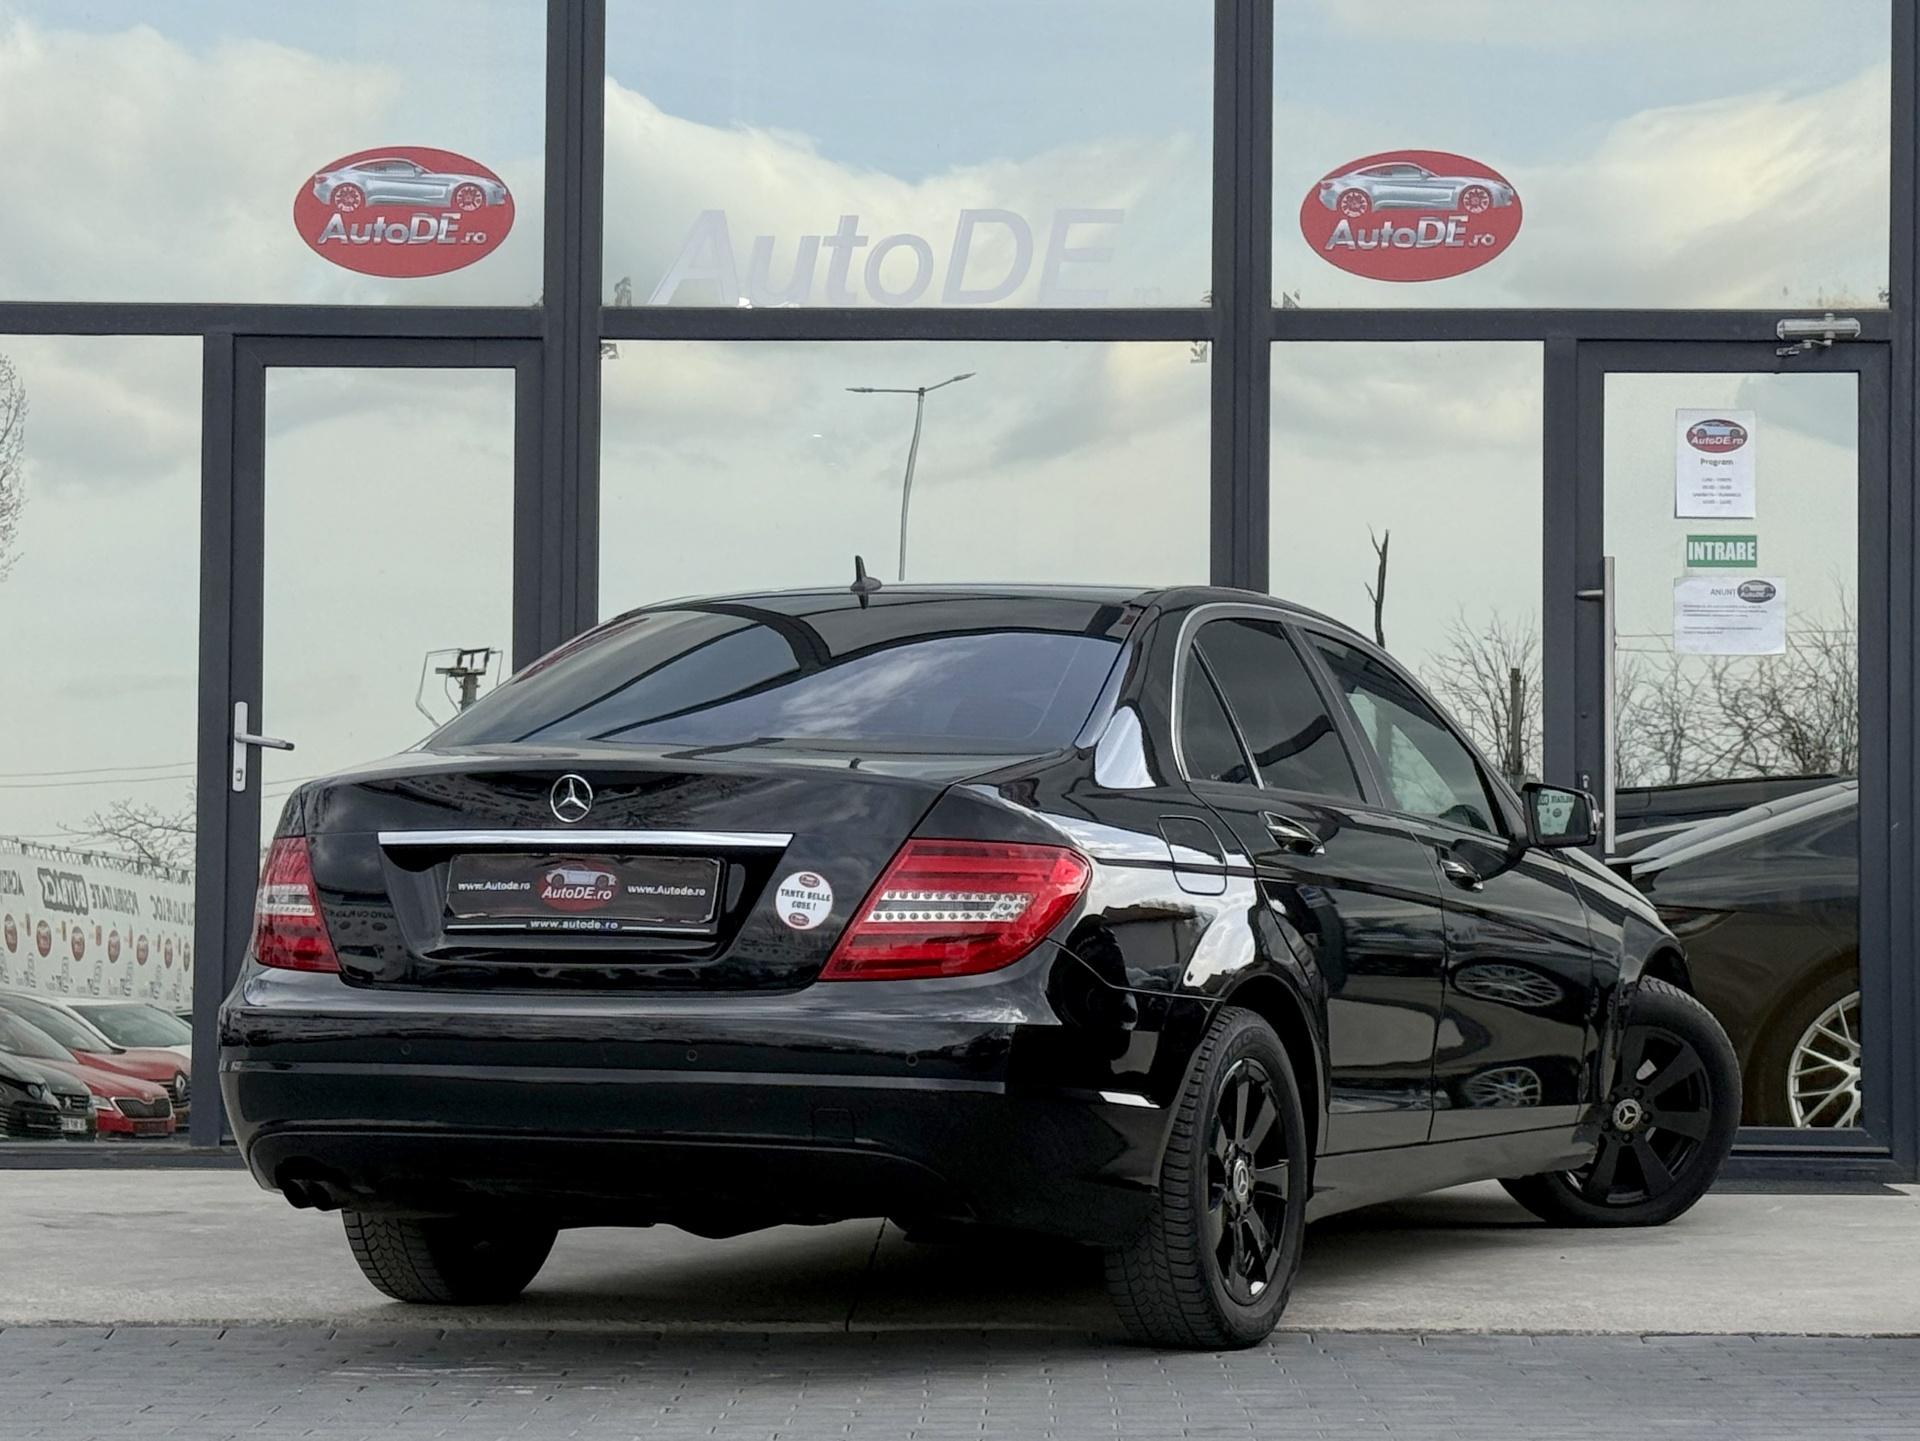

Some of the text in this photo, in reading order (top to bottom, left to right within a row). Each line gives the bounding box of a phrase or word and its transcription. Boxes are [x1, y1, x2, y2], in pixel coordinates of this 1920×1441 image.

[647, 209, 1125, 307] AutoDE
[1700, 458, 1734, 467] Program
[1688, 541, 1756, 561] INTRARE
[458, 880, 531, 891] www.Autode.ro
[627, 884, 706, 897] www.Autode.ro
[541, 885, 613, 900] AutoDE.ro
[781, 888, 831, 902] TANTE BELLE
[792, 900, 811, 910] COSE
[530, 919, 619, 930] www.autode.ro
